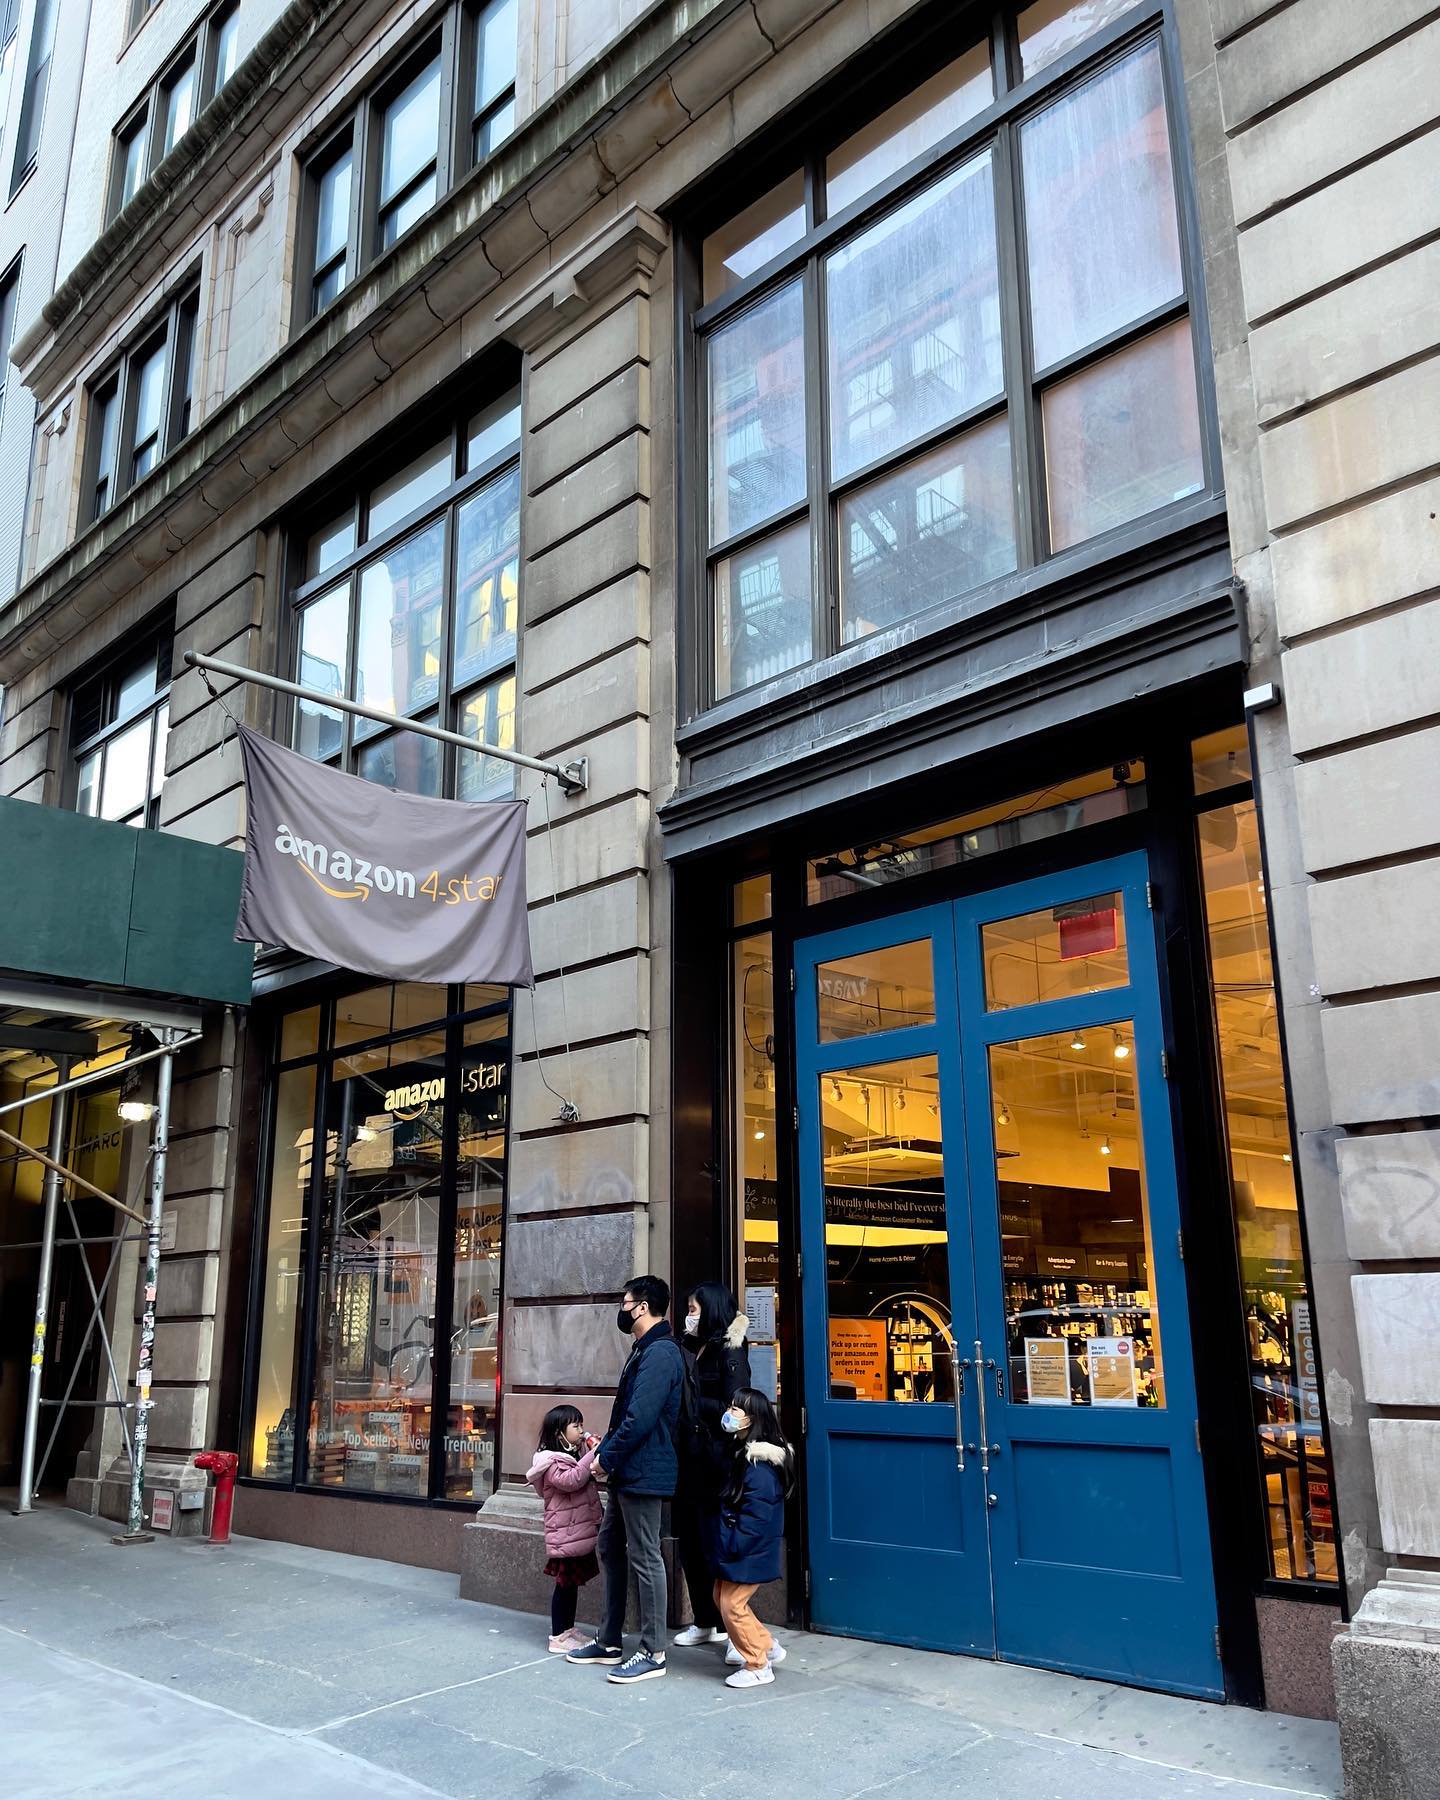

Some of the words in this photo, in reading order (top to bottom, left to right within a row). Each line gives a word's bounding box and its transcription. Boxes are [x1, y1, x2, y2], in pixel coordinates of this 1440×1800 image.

[274, 824, 416, 900] amazon
[420, 870, 503, 905] 4-star
[833, 1196, 863, 1209] literally
[864, 1199, 876, 1209] the
[877, 1200, 893, 1210] best
[894, 1201, 909, 1211] bed
[831, 1340, 844, 1348] Pick
[844, 1367, 853, 1375] for
[343, 1430, 361, 1447] Top
[363, 1431, 398, 1448] Sellers
[407, 1434, 431, 1451] New
[443, 1435, 494, 1456] Trending
